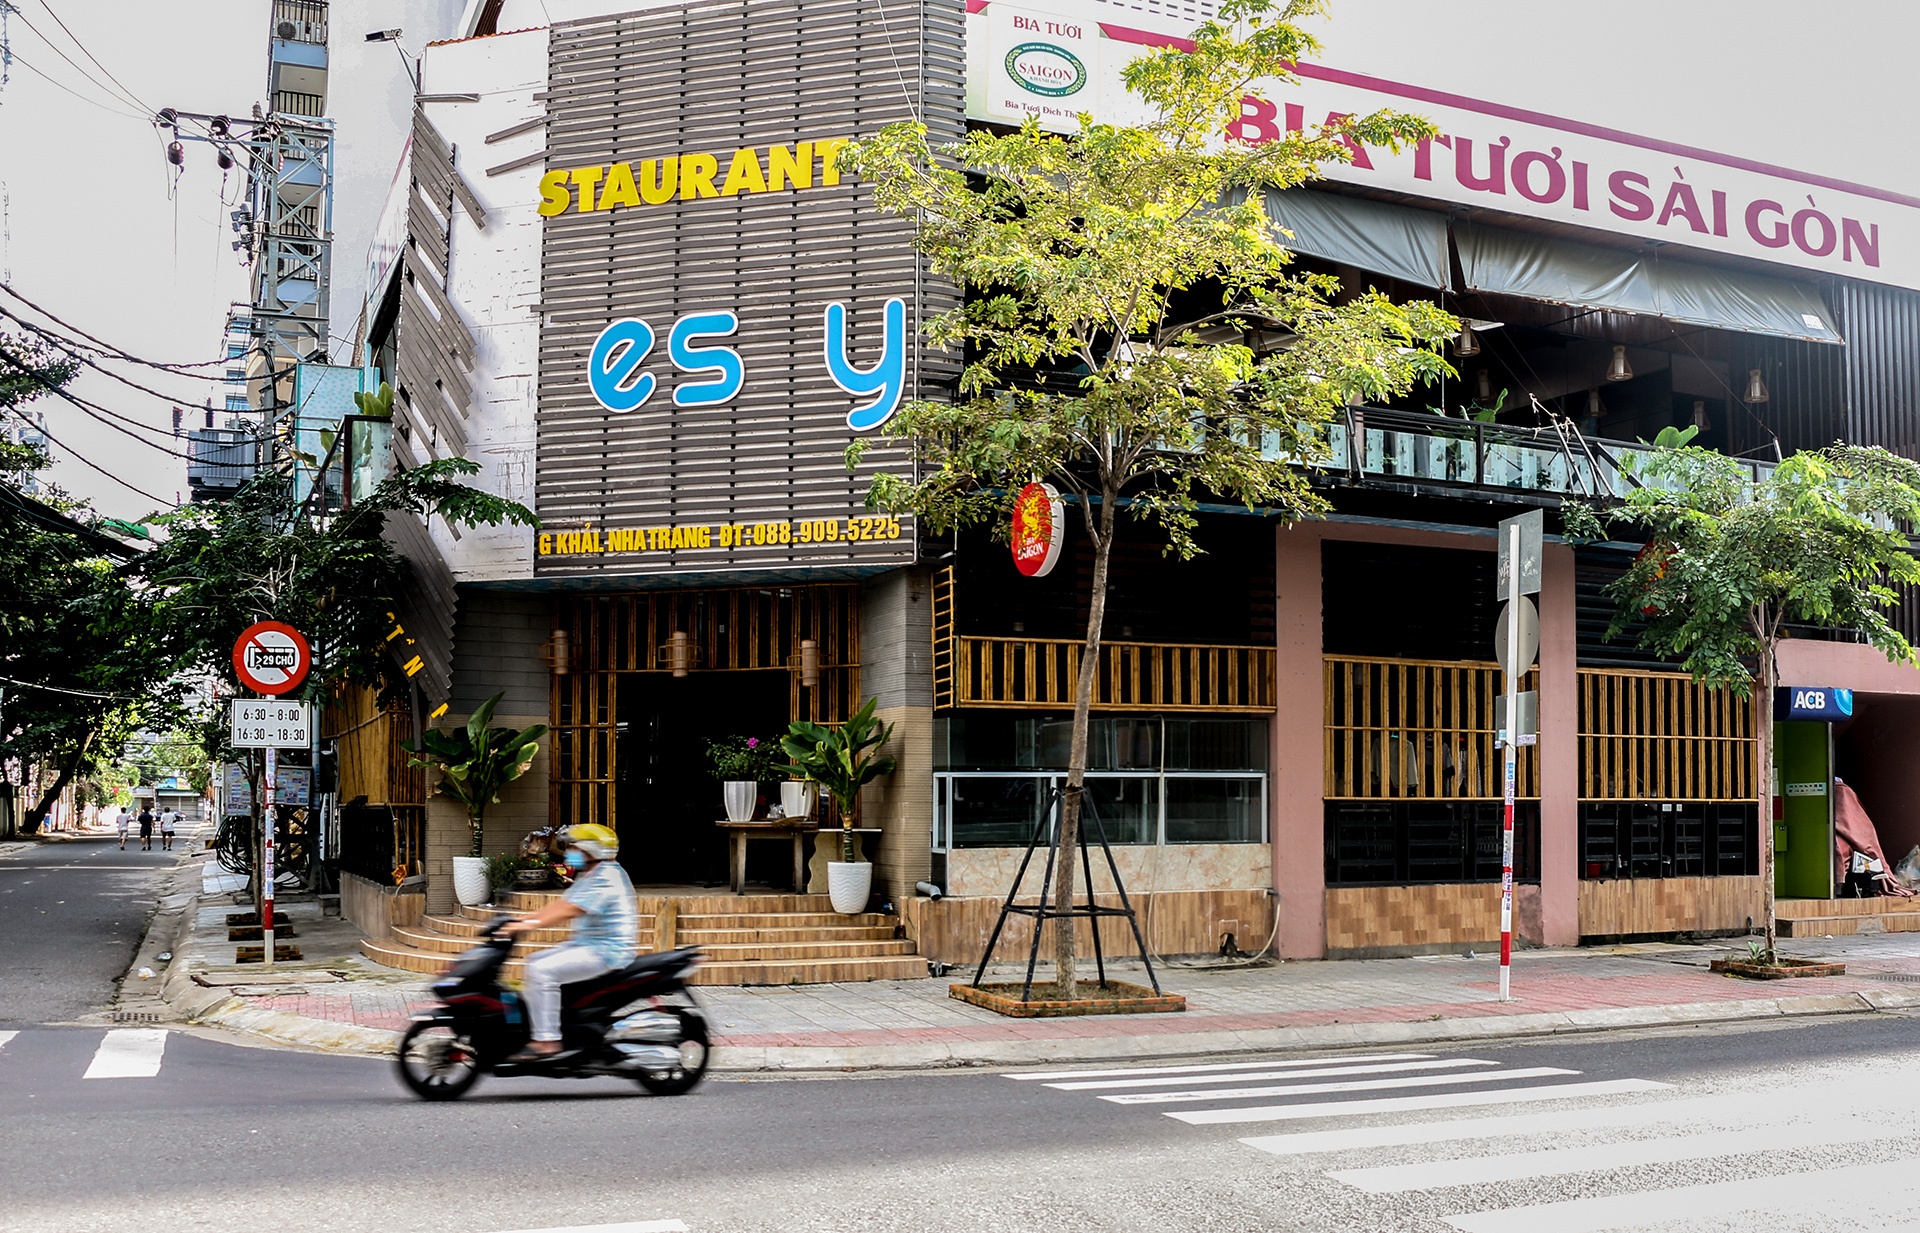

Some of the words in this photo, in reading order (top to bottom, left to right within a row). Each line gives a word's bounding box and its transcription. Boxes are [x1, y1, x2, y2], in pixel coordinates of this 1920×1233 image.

[1013, 15, 1040, 32] BIA
[1045, 21, 1082, 39] TƯƠI
[1018, 62, 1072, 81] SAIGON
[1005, 100, 1019, 109] Bia
[537, 138, 850, 216] STAURANT
[1395, 129, 1590, 211] TƯƠI
[1608, 166, 1729, 238] SÀI
[1744, 194, 1880, 268] GÒN
[1794, 690, 1826, 710] ACB
[243, 708, 266, 721] 6:30
[277, 709, 300, 721] 8:00
[237, 728, 265, 740] 16:30
[277, 728, 305, 741] 18:30
